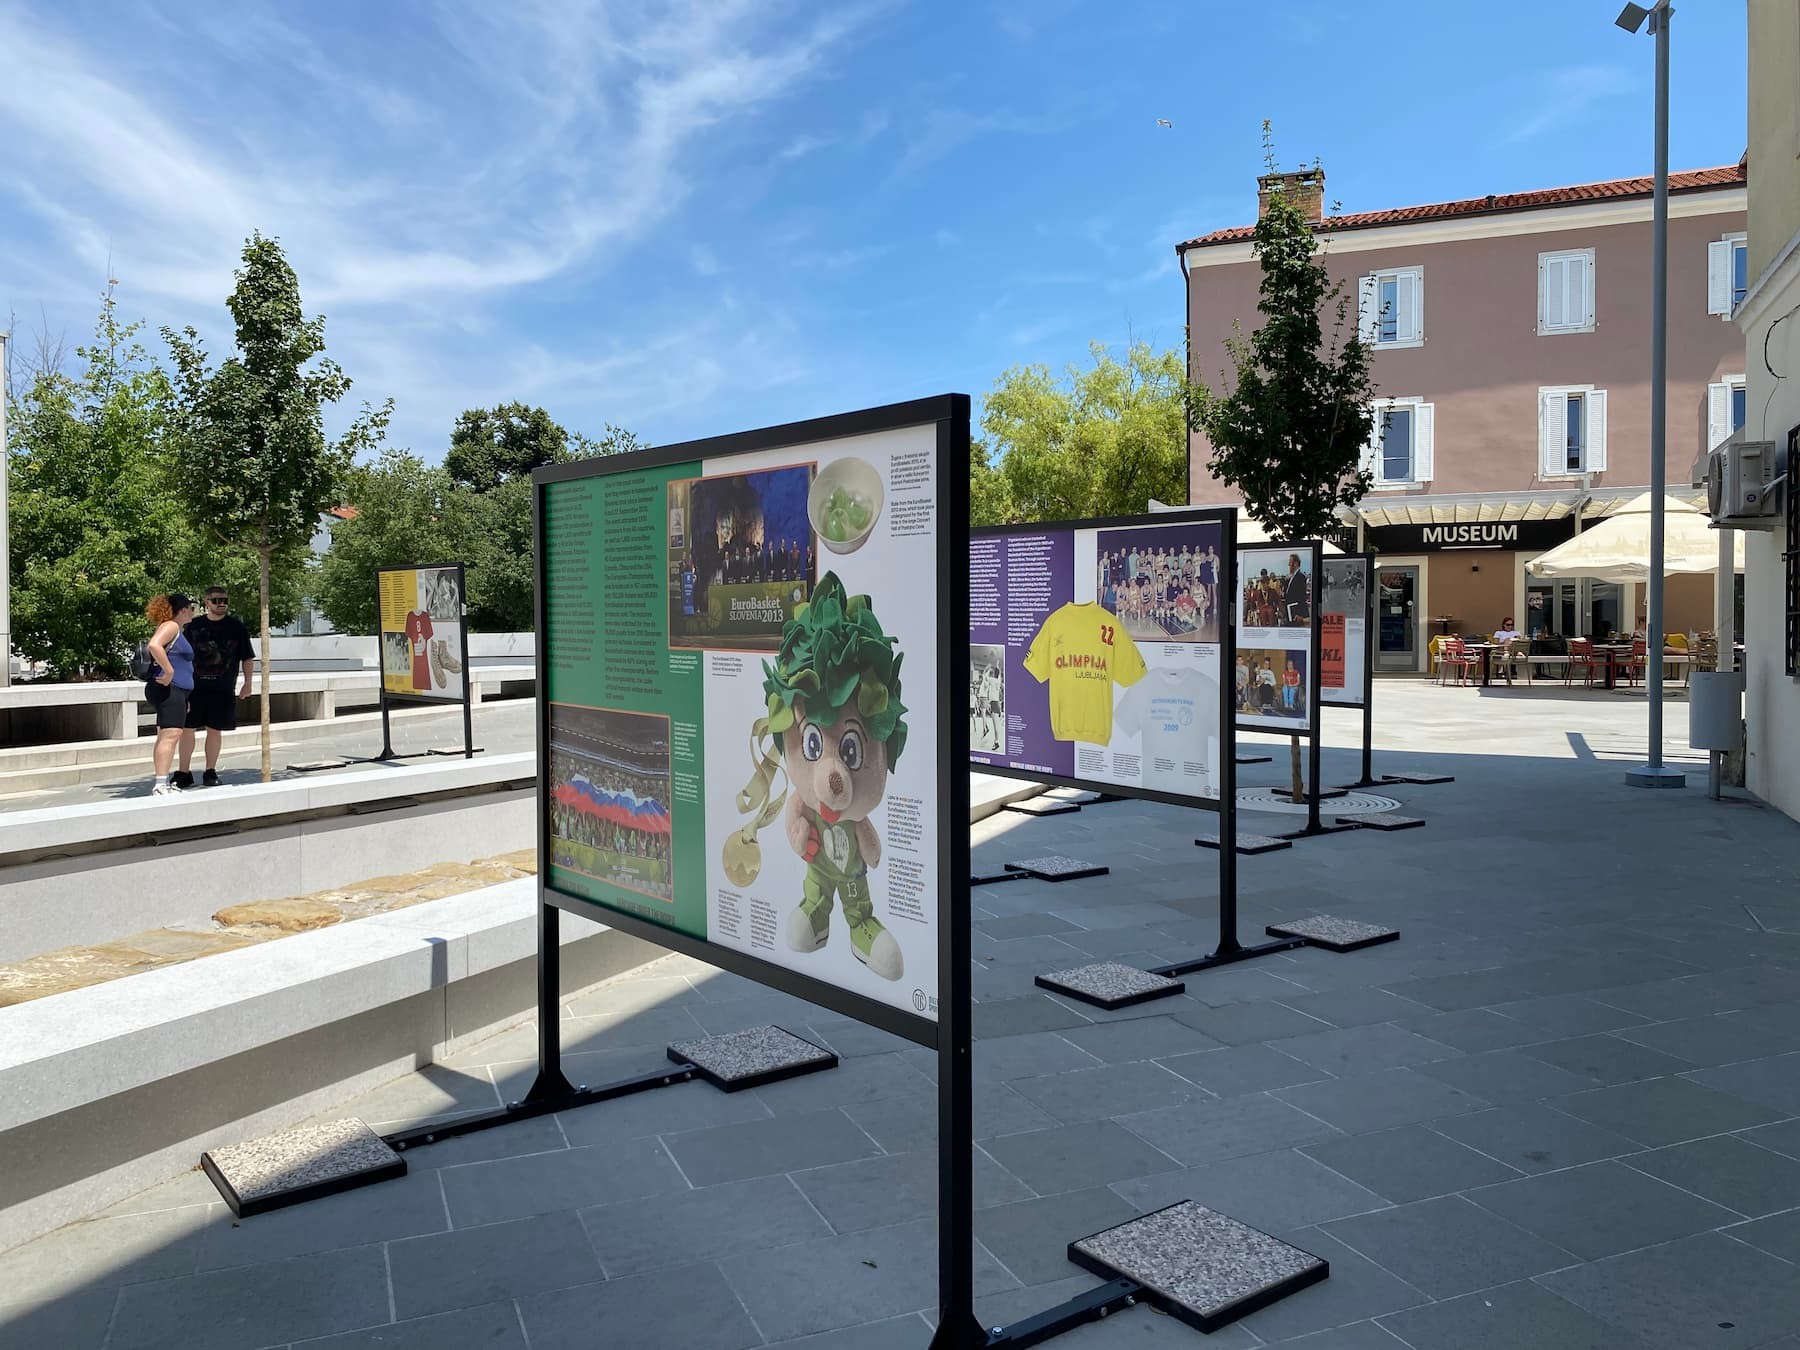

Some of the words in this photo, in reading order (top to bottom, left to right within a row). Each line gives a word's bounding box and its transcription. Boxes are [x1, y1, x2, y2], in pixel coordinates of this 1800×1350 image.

[1422, 524, 1518, 543] MUSEUM
[730, 596, 781, 610] EuroBasket
[1101, 624, 1115, 646] 22
[1055, 654, 1107, 672] OLIMPIJA
[847, 882, 858, 898] 13
